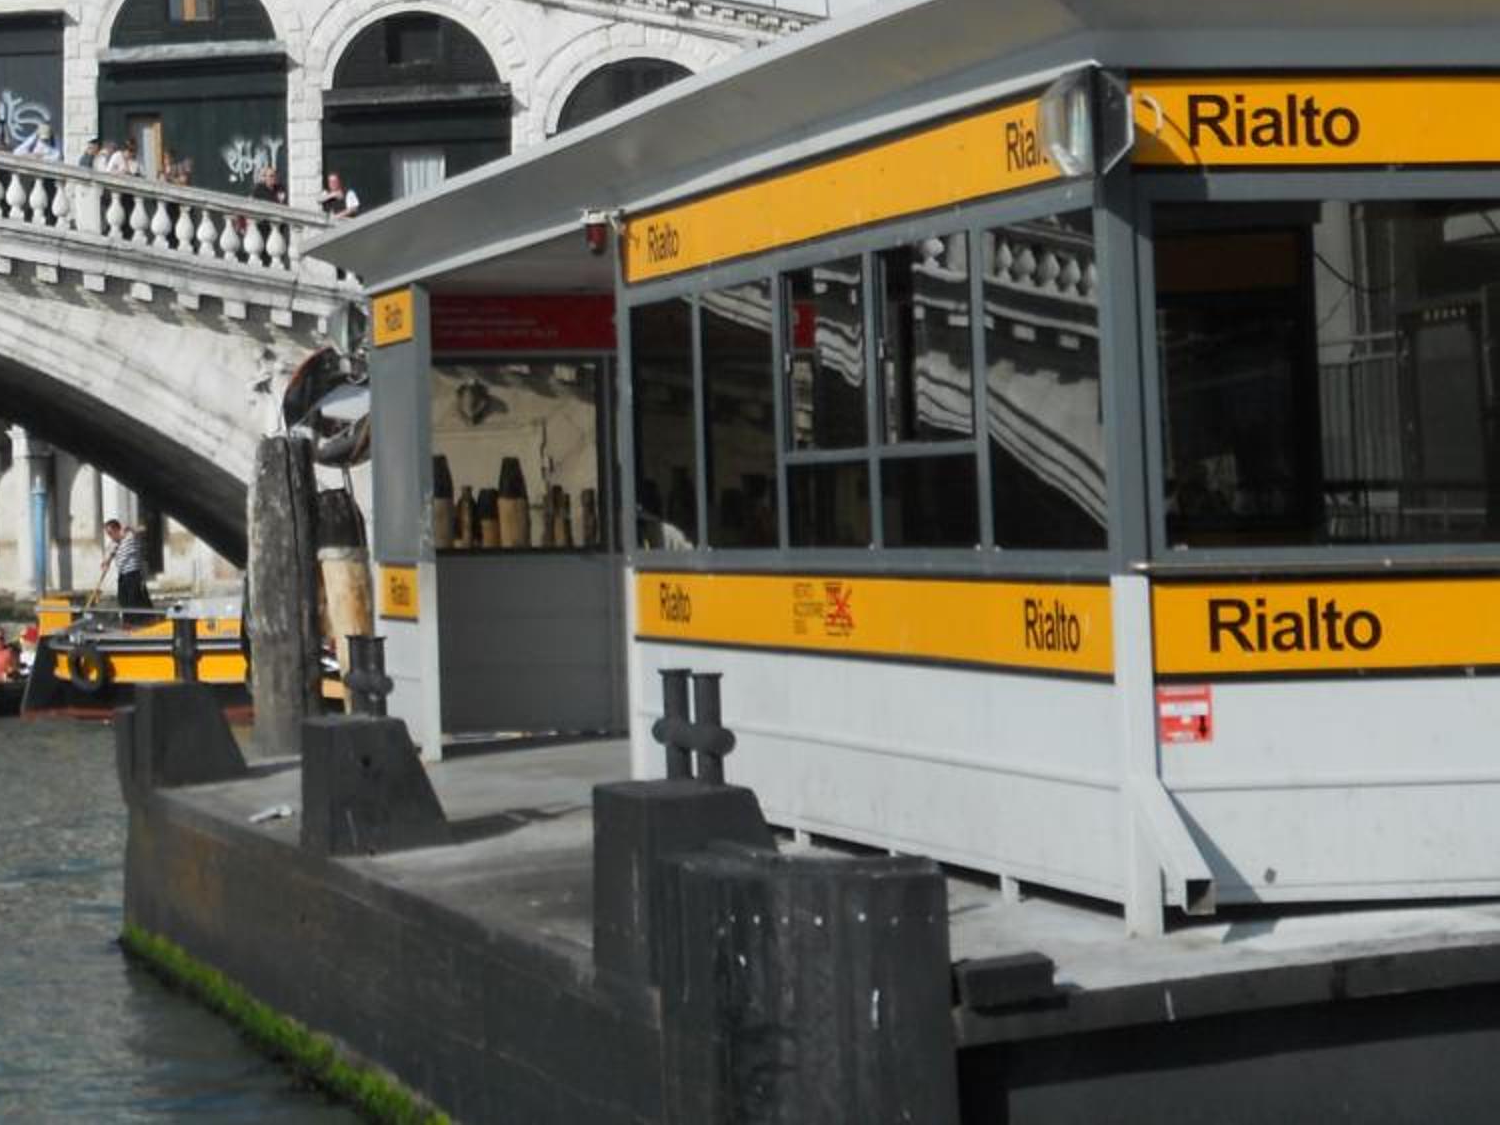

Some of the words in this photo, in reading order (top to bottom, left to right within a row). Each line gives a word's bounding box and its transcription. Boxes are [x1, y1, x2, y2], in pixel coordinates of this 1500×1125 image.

[1187, 92, 1361, 148] Rialto
[647, 222, 679, 264] Rialto
[659, 581, 692, 624] Rialto
[1023, 598, 1081, 653] Rialto
[1207, 597, 1383, 654] Rialto
